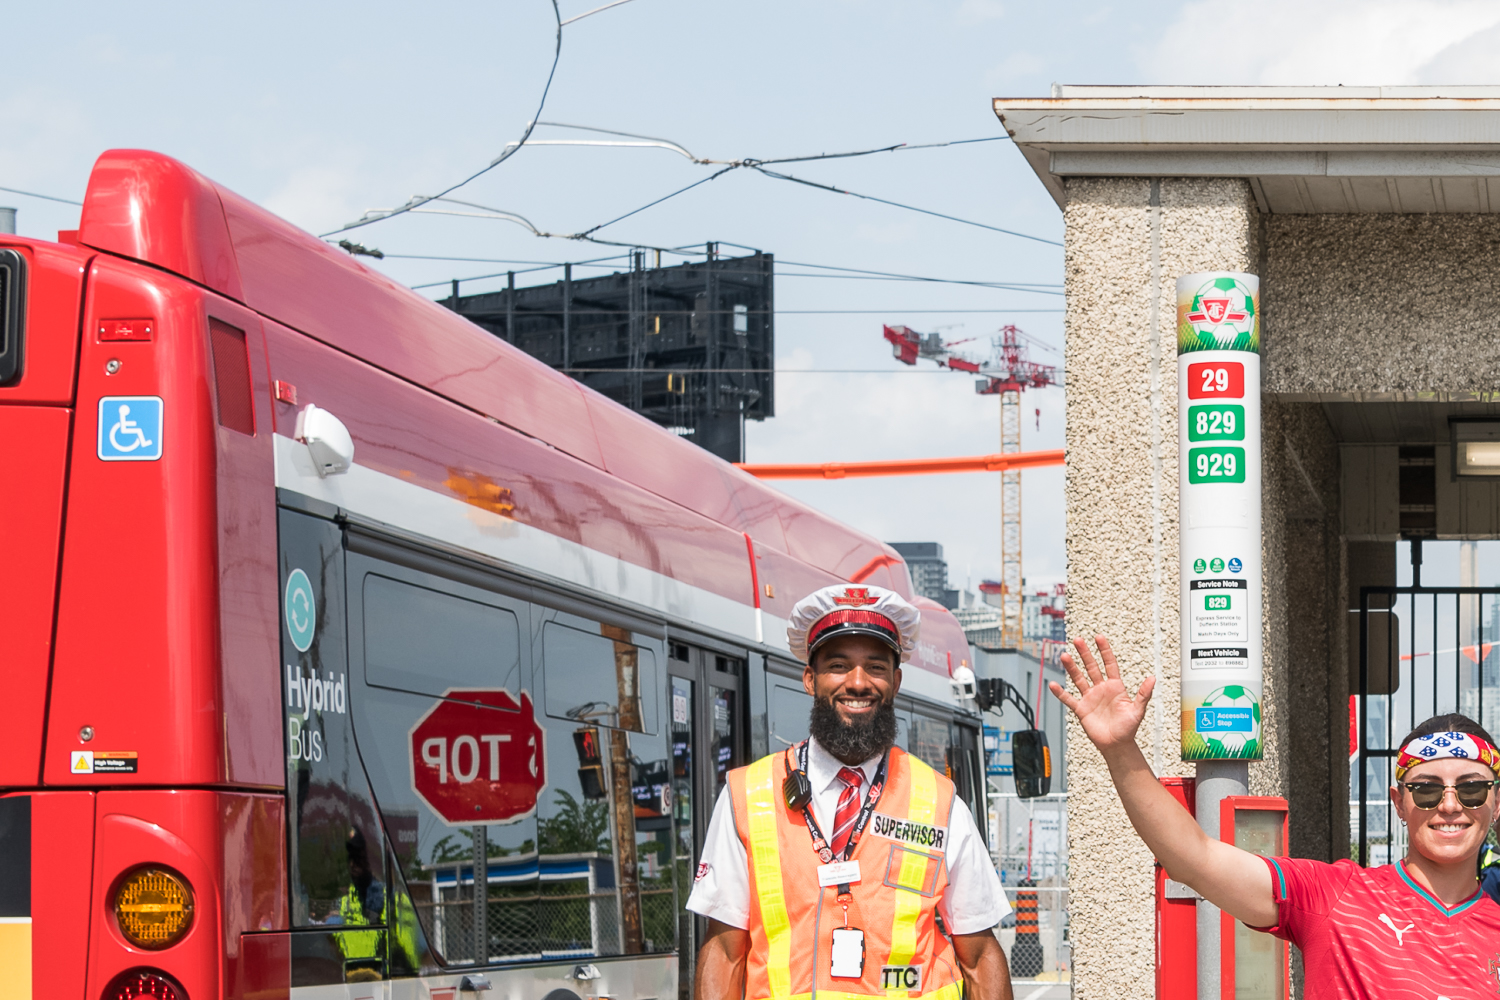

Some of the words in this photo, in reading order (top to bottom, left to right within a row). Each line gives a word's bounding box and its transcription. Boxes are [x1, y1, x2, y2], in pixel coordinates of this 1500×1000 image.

[1201, 368, 1229, 392] 29
[1196, 410, 1236, 435] 829
[1196, 452, 1237, 477] 929
[1208, 597, 1228, 609] 829
[1197, 649, 1214, 657] Next
[1214, 648, 1240, 656] Vehicle
[286, 664, 347, 721] Hybrid
[1216, 720, 1233, 728] Stop
[288, 716, 322, 762] Bus
[873, 814, 945, 849] SUPERVISOR
[882, 966, 919, 989] TTC
